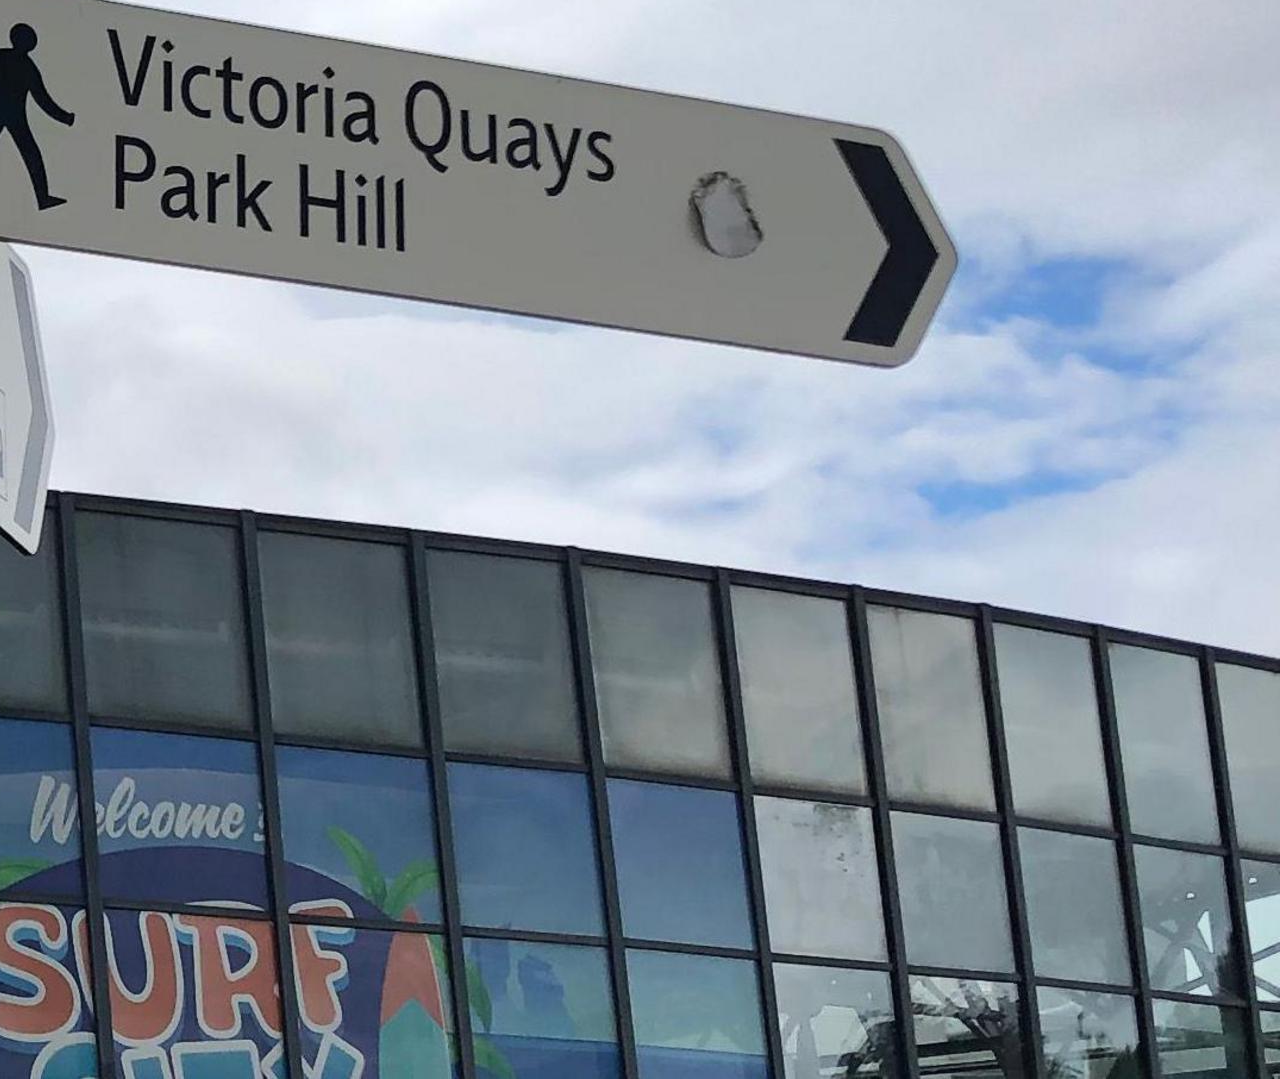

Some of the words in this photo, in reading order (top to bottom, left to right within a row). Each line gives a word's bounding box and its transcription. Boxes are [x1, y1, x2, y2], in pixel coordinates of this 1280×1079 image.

[106, 28, 380, 146] Victoria
[404, 80, 616, 197] Quays
[114, 134, 273, 233] Park
[298, 163, 406, 252] Hill
